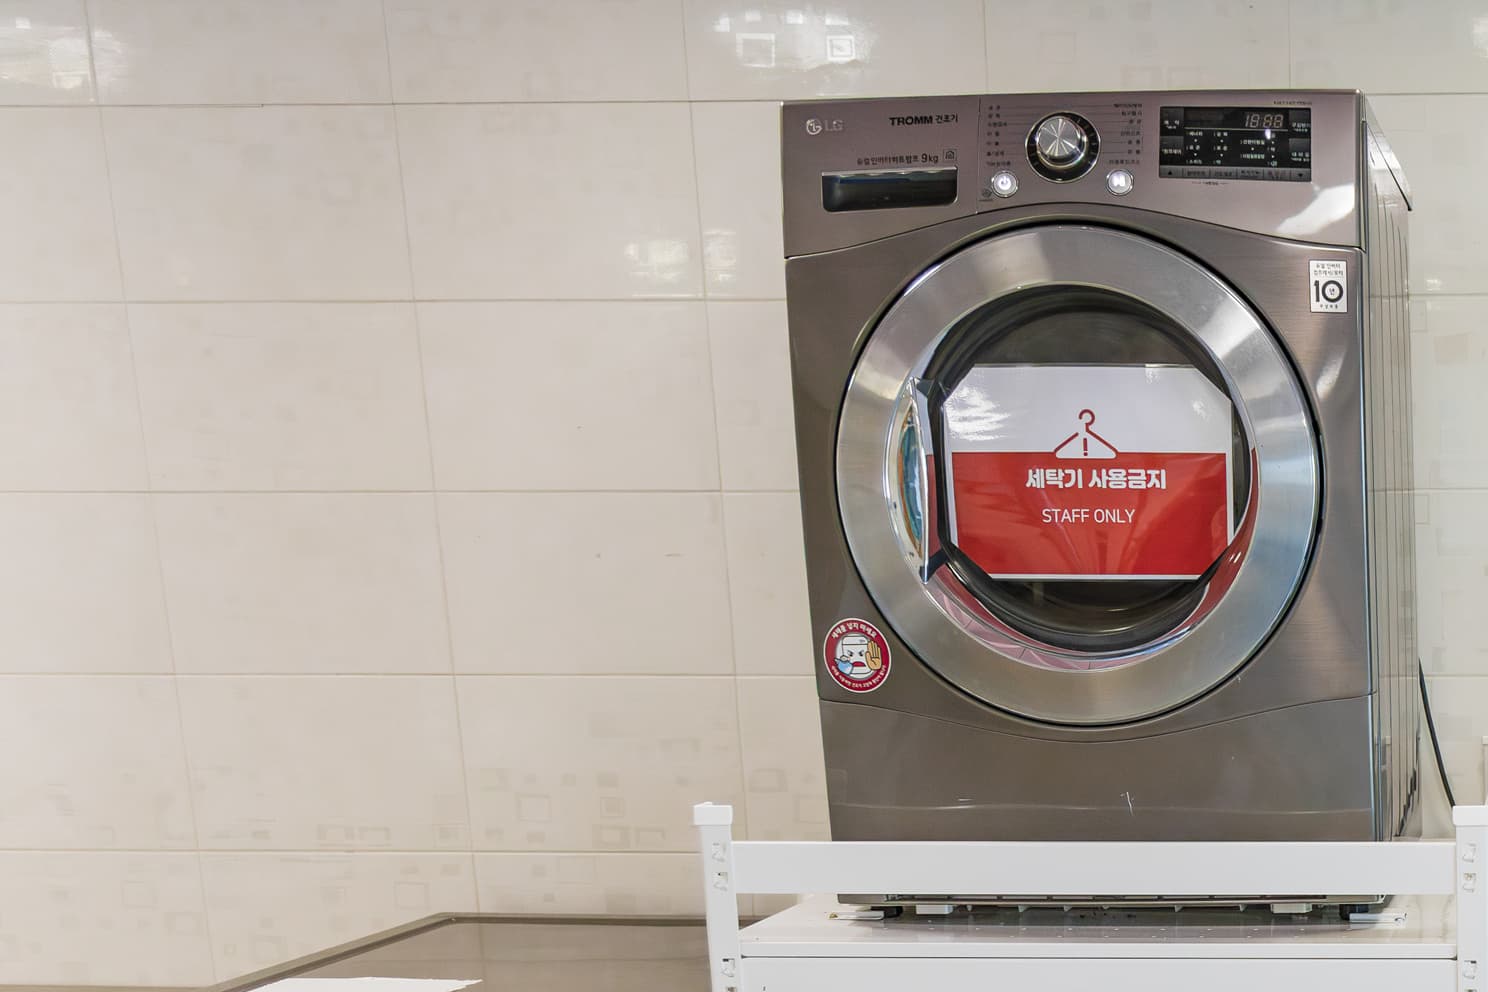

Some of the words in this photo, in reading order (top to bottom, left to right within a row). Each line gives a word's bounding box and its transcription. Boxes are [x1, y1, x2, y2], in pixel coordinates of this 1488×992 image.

[889, 115, 933, 126] TROMM
[1026, 468, 1083, 489] 세탁기
[1088, 468, 1167, 490] 사용금지
[1042, 508, 1090, 523] STAFF
[1093, 508, 1136, 523] ONLY
